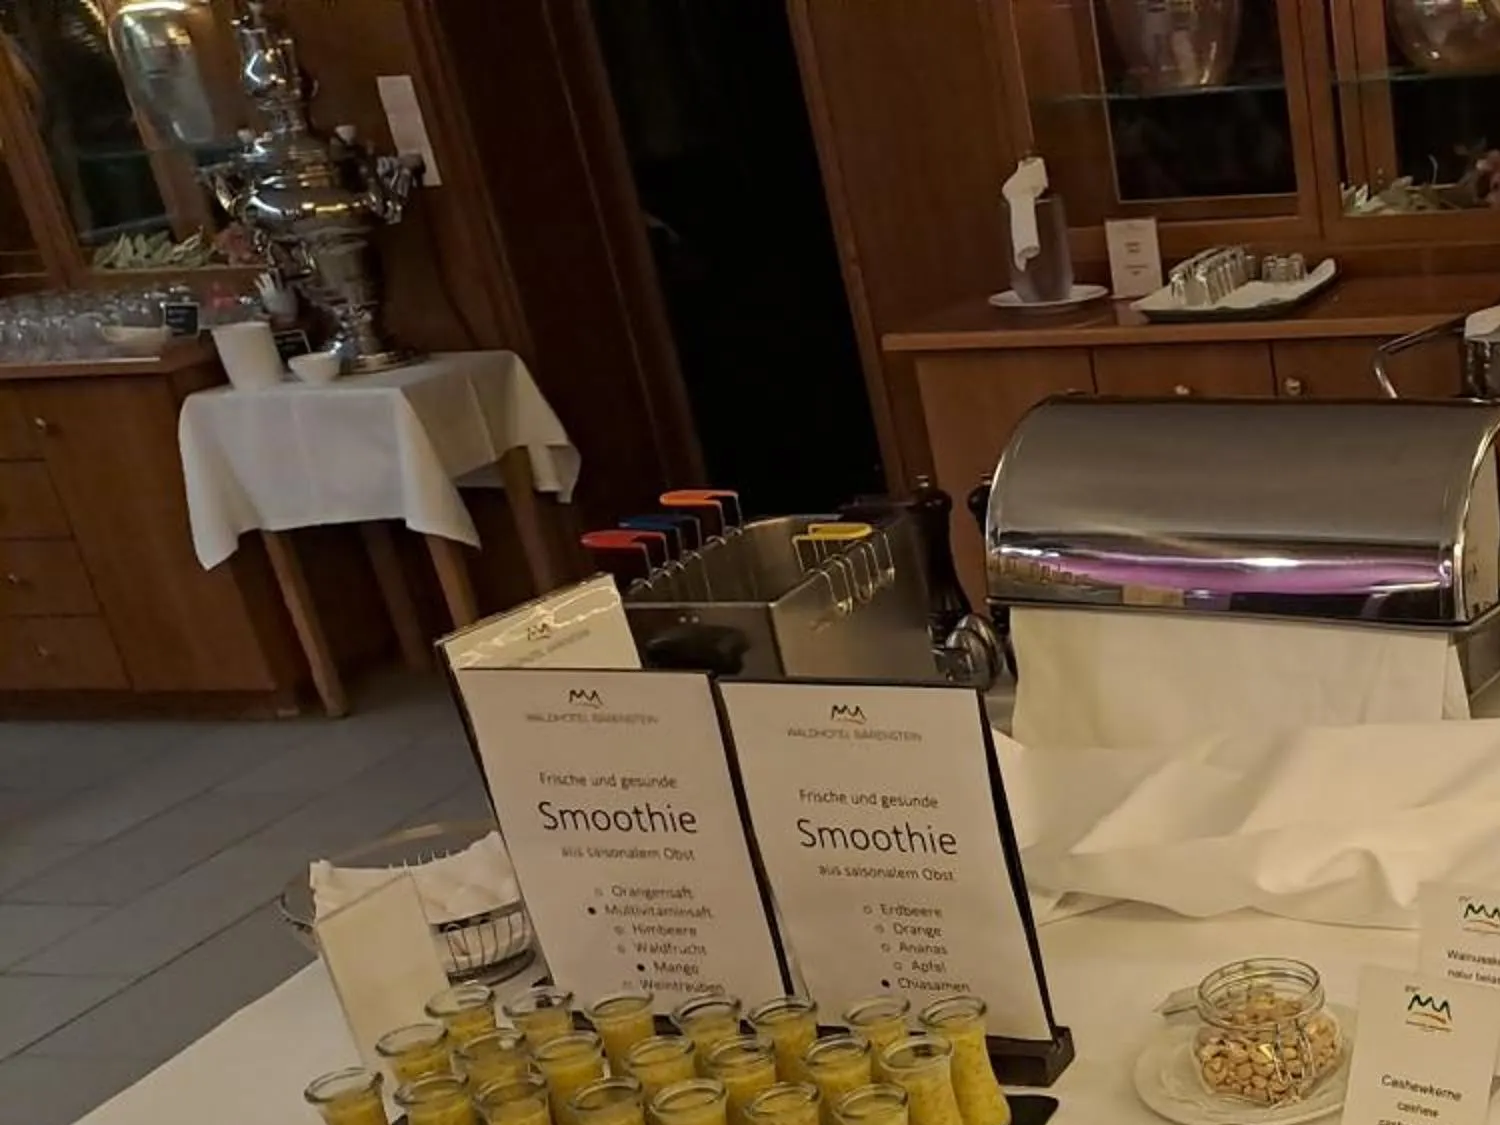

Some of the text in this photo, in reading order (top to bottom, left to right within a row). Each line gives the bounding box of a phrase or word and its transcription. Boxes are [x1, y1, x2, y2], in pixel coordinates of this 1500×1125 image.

[539, 771, 678, 790] Frische und gesunde
[799, 788, 938, 809] Frische und gesunde
[538, 801, 698, 834] Smoothie
[796, 818, 957, 855] Smoothie
[663, 847, 695, 862] Obst
[922, 867, 955, 882] Obst
[880, 903, 943, 919] Erdbeere
[893, 922, 942, 939] Orange
[899, 941, 948, 956] Ananas
[653, 959, 699, 977] Mango
[897, 976, 971, 993] Chiasamen
